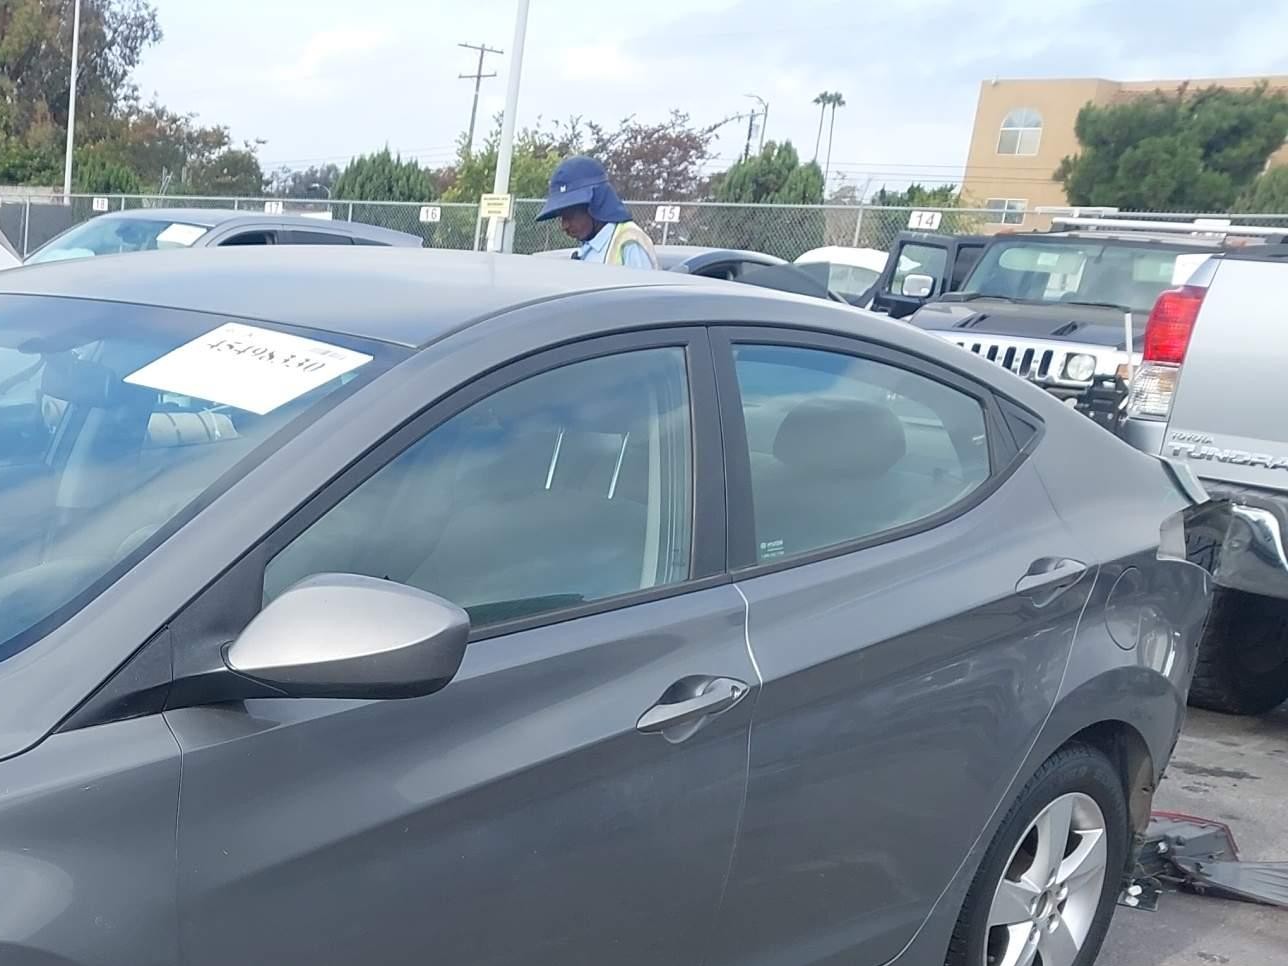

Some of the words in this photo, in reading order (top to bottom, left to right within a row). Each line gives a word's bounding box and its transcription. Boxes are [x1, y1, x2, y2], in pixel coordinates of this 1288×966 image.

[424, 207, 438, 220] 16
[662, 207, 675, 220] 15
[916, 212, 935, 227] 14
